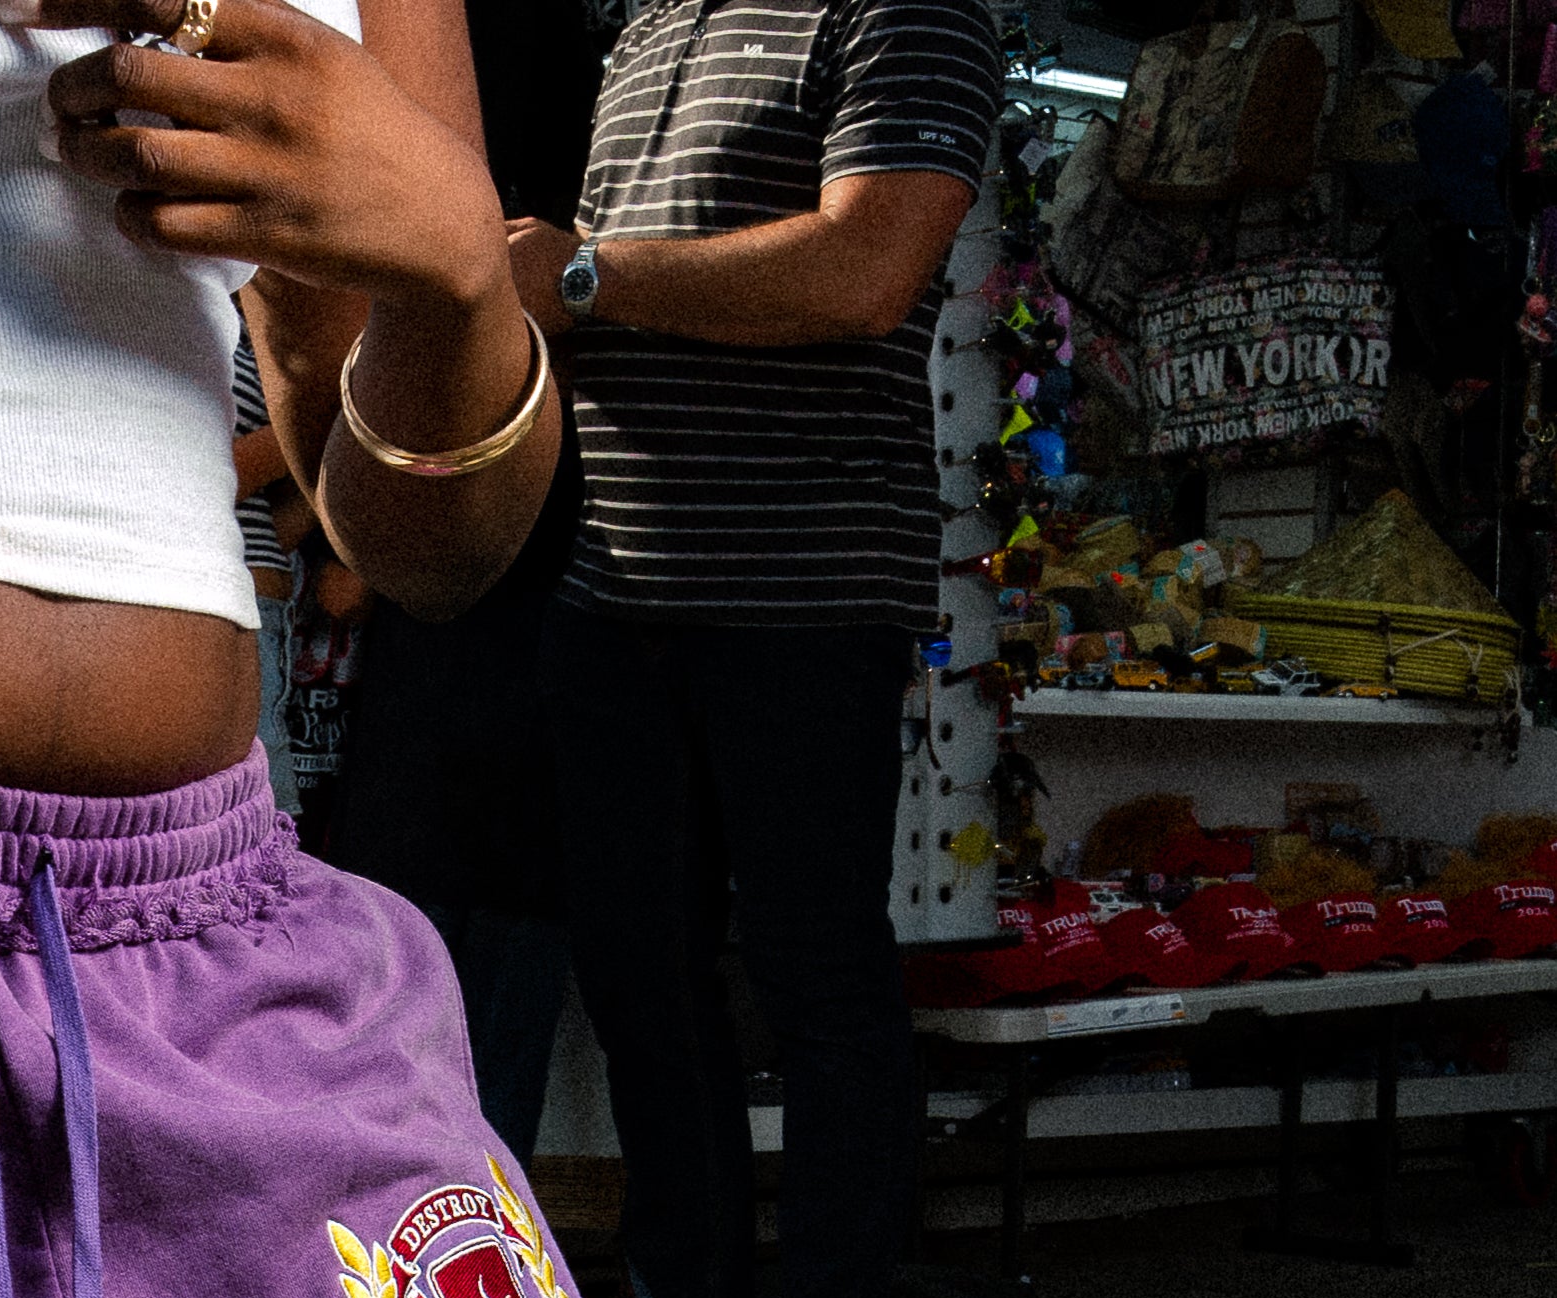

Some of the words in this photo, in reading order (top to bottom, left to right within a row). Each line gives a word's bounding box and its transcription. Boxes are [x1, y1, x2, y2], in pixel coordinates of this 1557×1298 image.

[1148, 346, 1227, 407] NEW
[1237, 334, 1343, 389] YORK
[1040, 911, 1089, 936] TRUM
[399, 1193, 492, 1253] DESTROY
